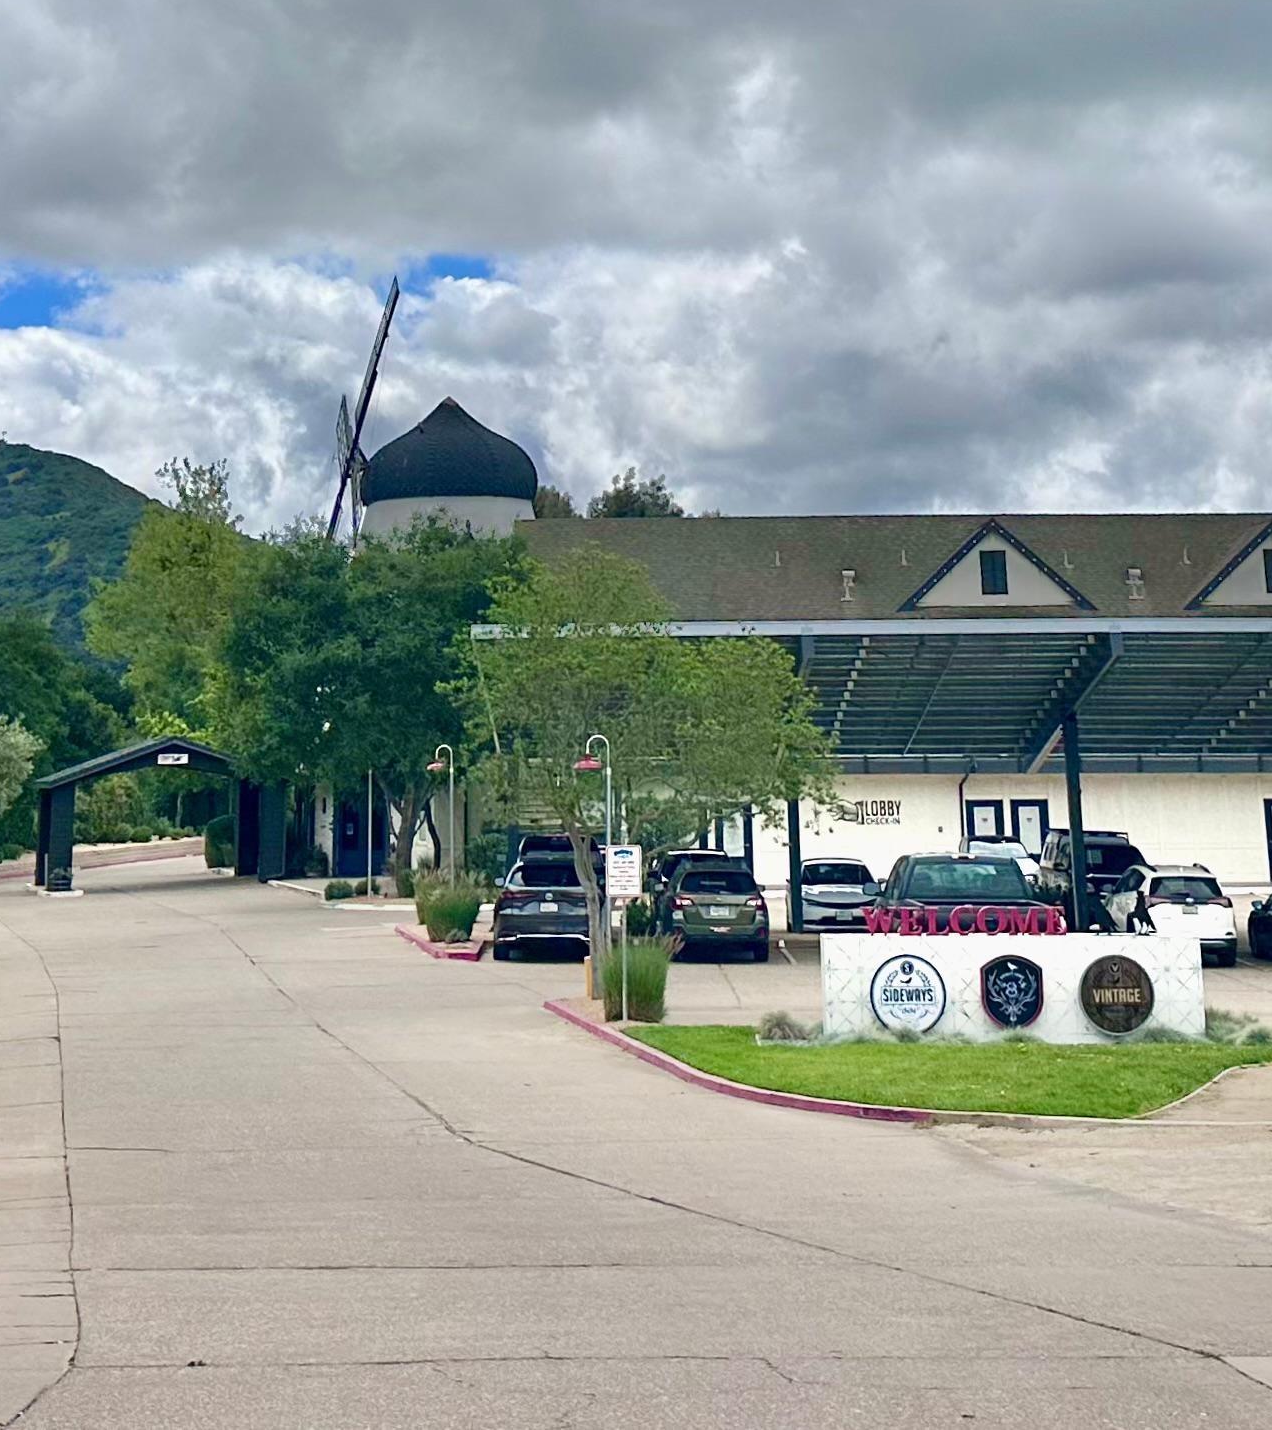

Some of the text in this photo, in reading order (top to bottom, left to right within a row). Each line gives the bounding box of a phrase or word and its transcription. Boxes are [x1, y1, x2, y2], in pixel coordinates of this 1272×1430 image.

[865, 800, 901, 817] LOBBY
[865, 817, 901, 825] CHECK-IN
[860, 904, 1067, 936] WELCOME
[882, 988, 934, 1002] SIDEWAYS
[1092, 988, 1142, 1003] VINTAGE
